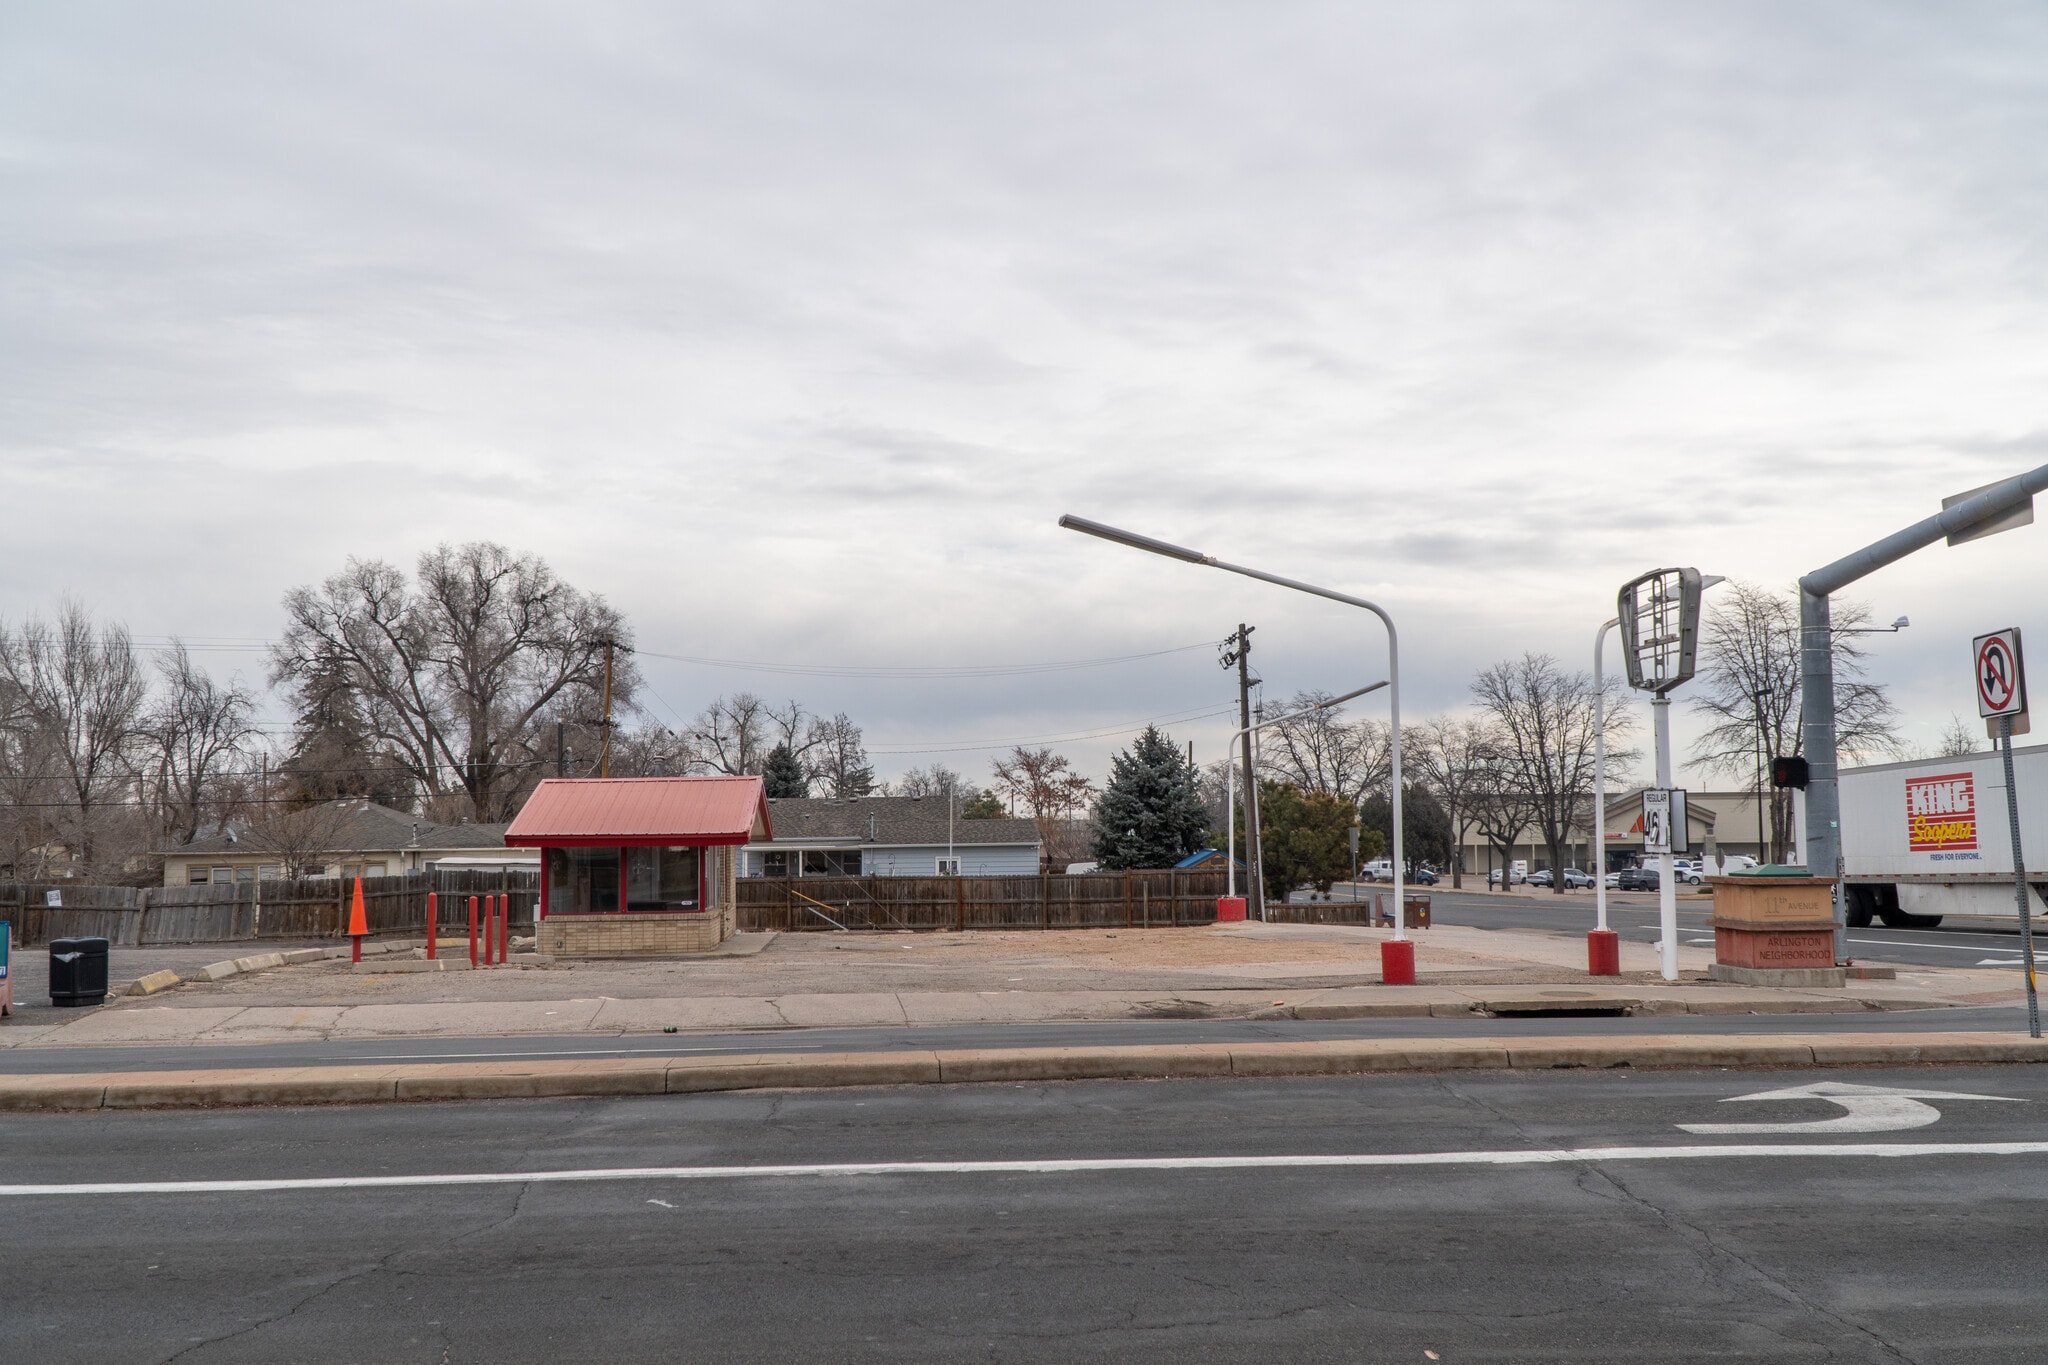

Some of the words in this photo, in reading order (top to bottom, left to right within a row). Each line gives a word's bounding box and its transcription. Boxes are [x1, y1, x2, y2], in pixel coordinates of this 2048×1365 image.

[1646, 794, 1667, 802] REGULAR
[1911, 781, 1969, 816] KING
[1912, 815, 1972, 848] Soopers
[1764, 896, 1788, 914] 11th
[1788, 902, 1819, 911] AVENUE
[1768, 937, 1820, 946] ARLINGTON
[1759, 950, 1831, 960] NEIGHBORHOOD
